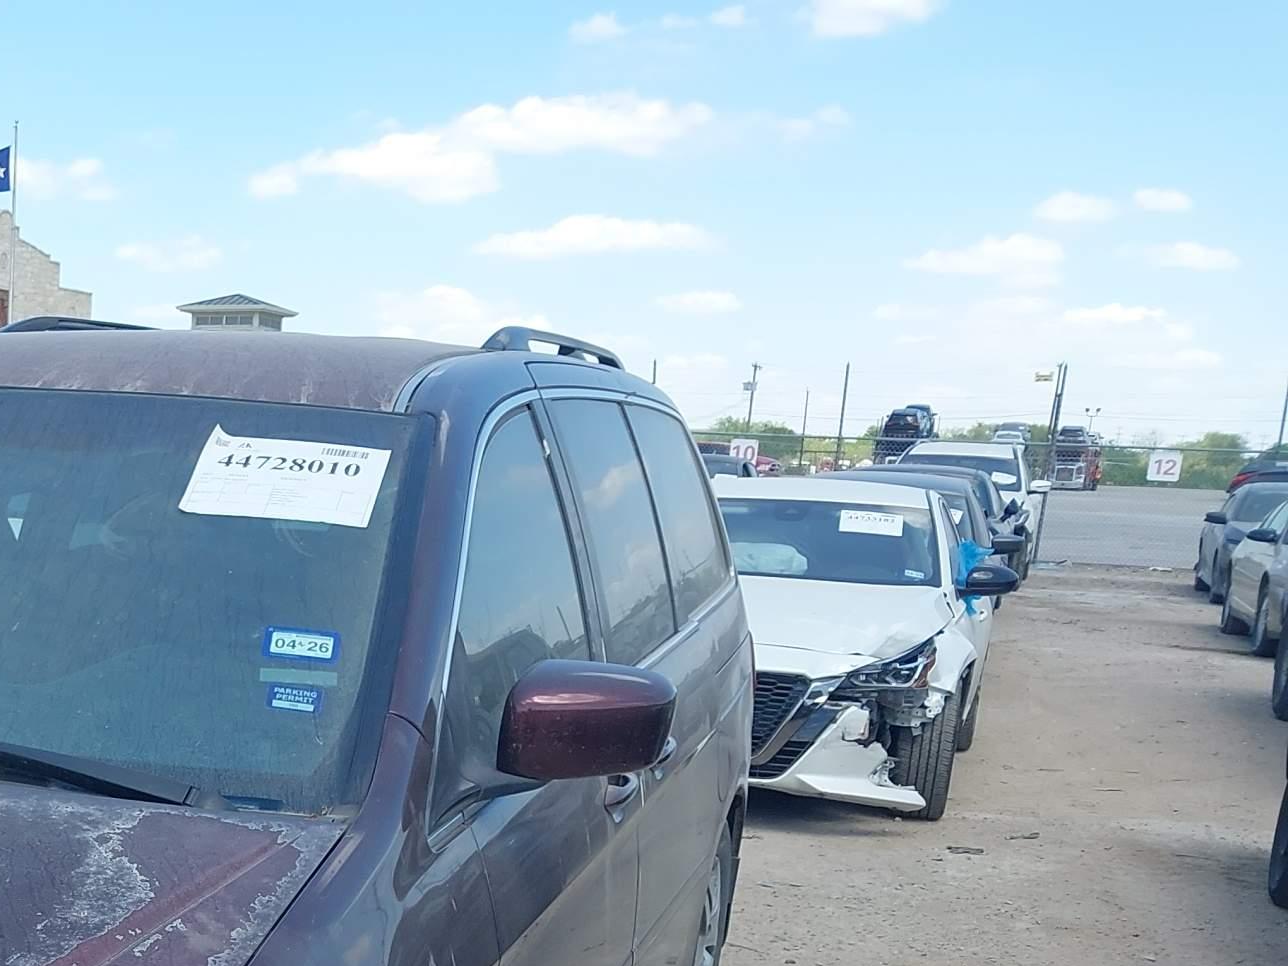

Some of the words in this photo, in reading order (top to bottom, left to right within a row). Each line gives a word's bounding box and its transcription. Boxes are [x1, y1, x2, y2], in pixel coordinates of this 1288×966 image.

[732, 445, 756, 461] 10
[217, 453, 361, 477] 44728010
[1154, 459, 1177, 475] 12
[274, 687, 318, 699] PARKING
[275, 693, 314, 704] PERMIT
